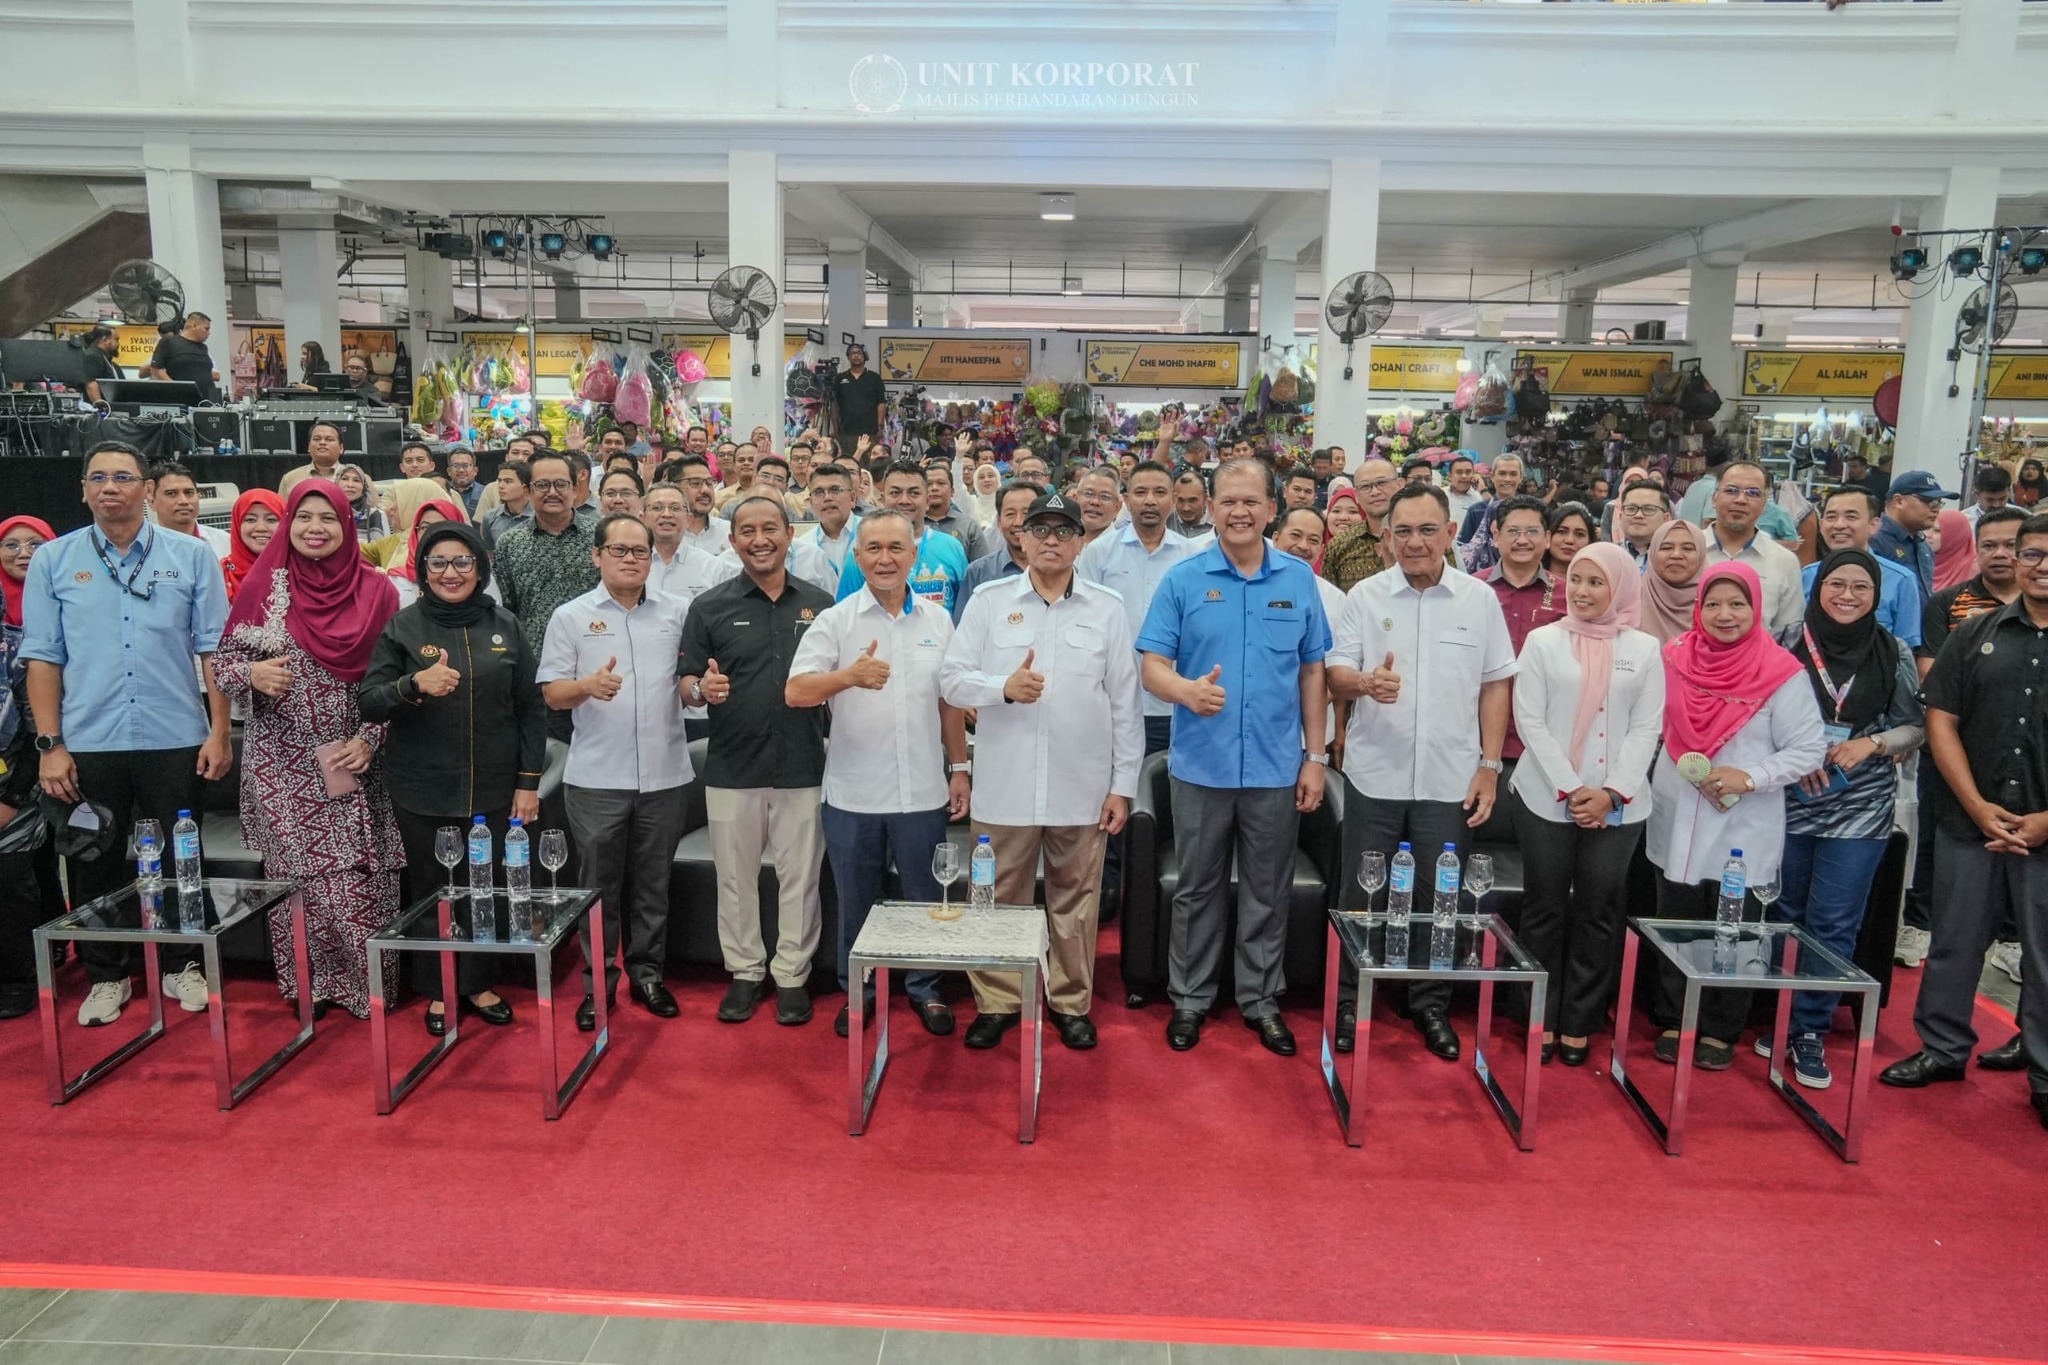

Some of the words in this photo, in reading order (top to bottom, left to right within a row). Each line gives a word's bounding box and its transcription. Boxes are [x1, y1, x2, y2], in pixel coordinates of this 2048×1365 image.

[1139, 359, 1156, 367] CHE
[1158, 359, 1184, 367] MOHD
[1186, 359, 1216, 368] SHAFRI
[1408, 364, 1440, 373] CRAFT
[1582, 368, 1607, 377] WAN
[1610, 369, 1643, 378] ISMAIL
[1816, 369, 1830, 379] AL
[1833, 369, 1868, 379] SALAH
